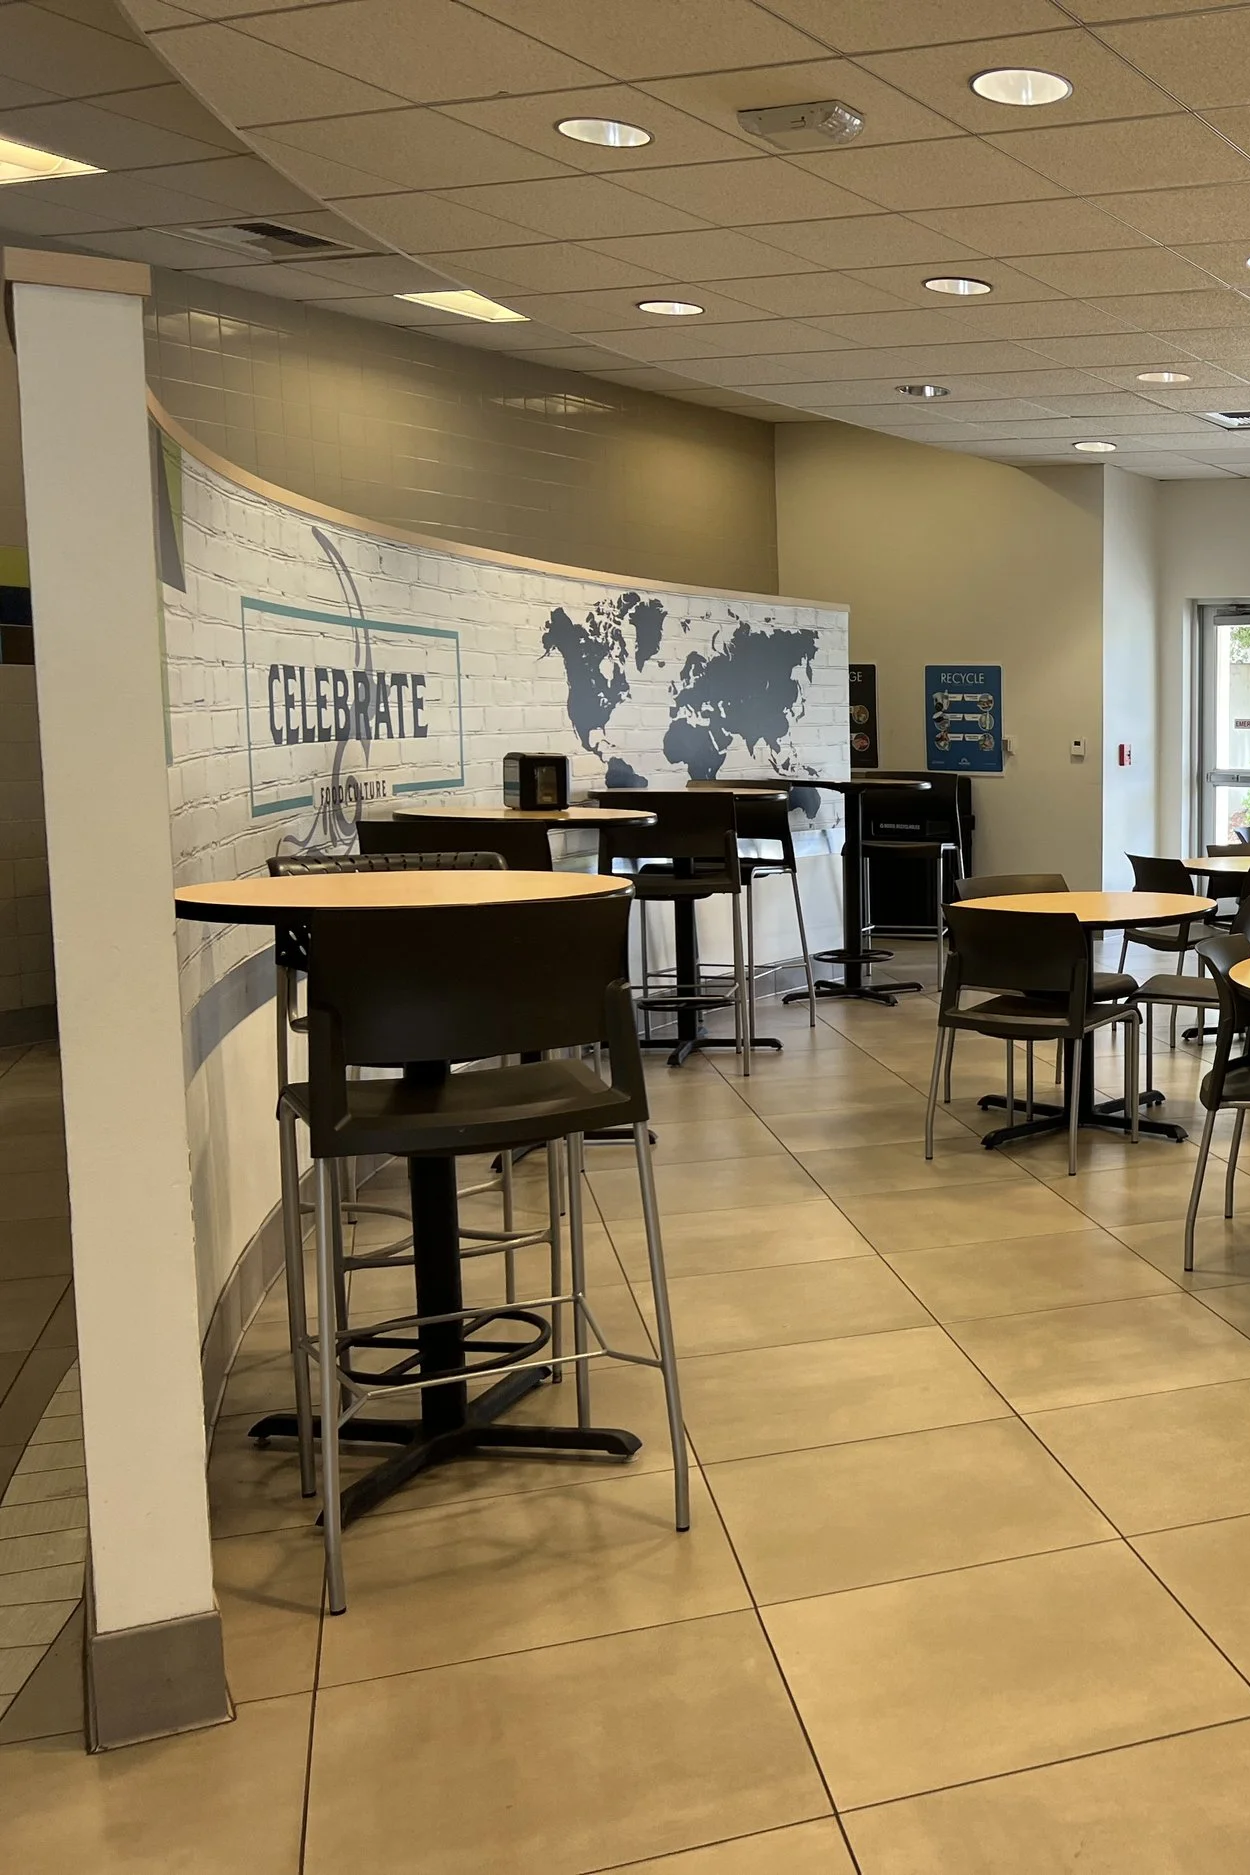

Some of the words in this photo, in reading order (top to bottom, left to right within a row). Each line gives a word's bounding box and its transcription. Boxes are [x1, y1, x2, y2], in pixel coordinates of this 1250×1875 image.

[940, 673, 984, 684] RECYCLE
[268, 664, 428, 745] CELEBRATE
[320, 785, 343, 806] FOOD
[348, 780, 386, 802] CULTURE
